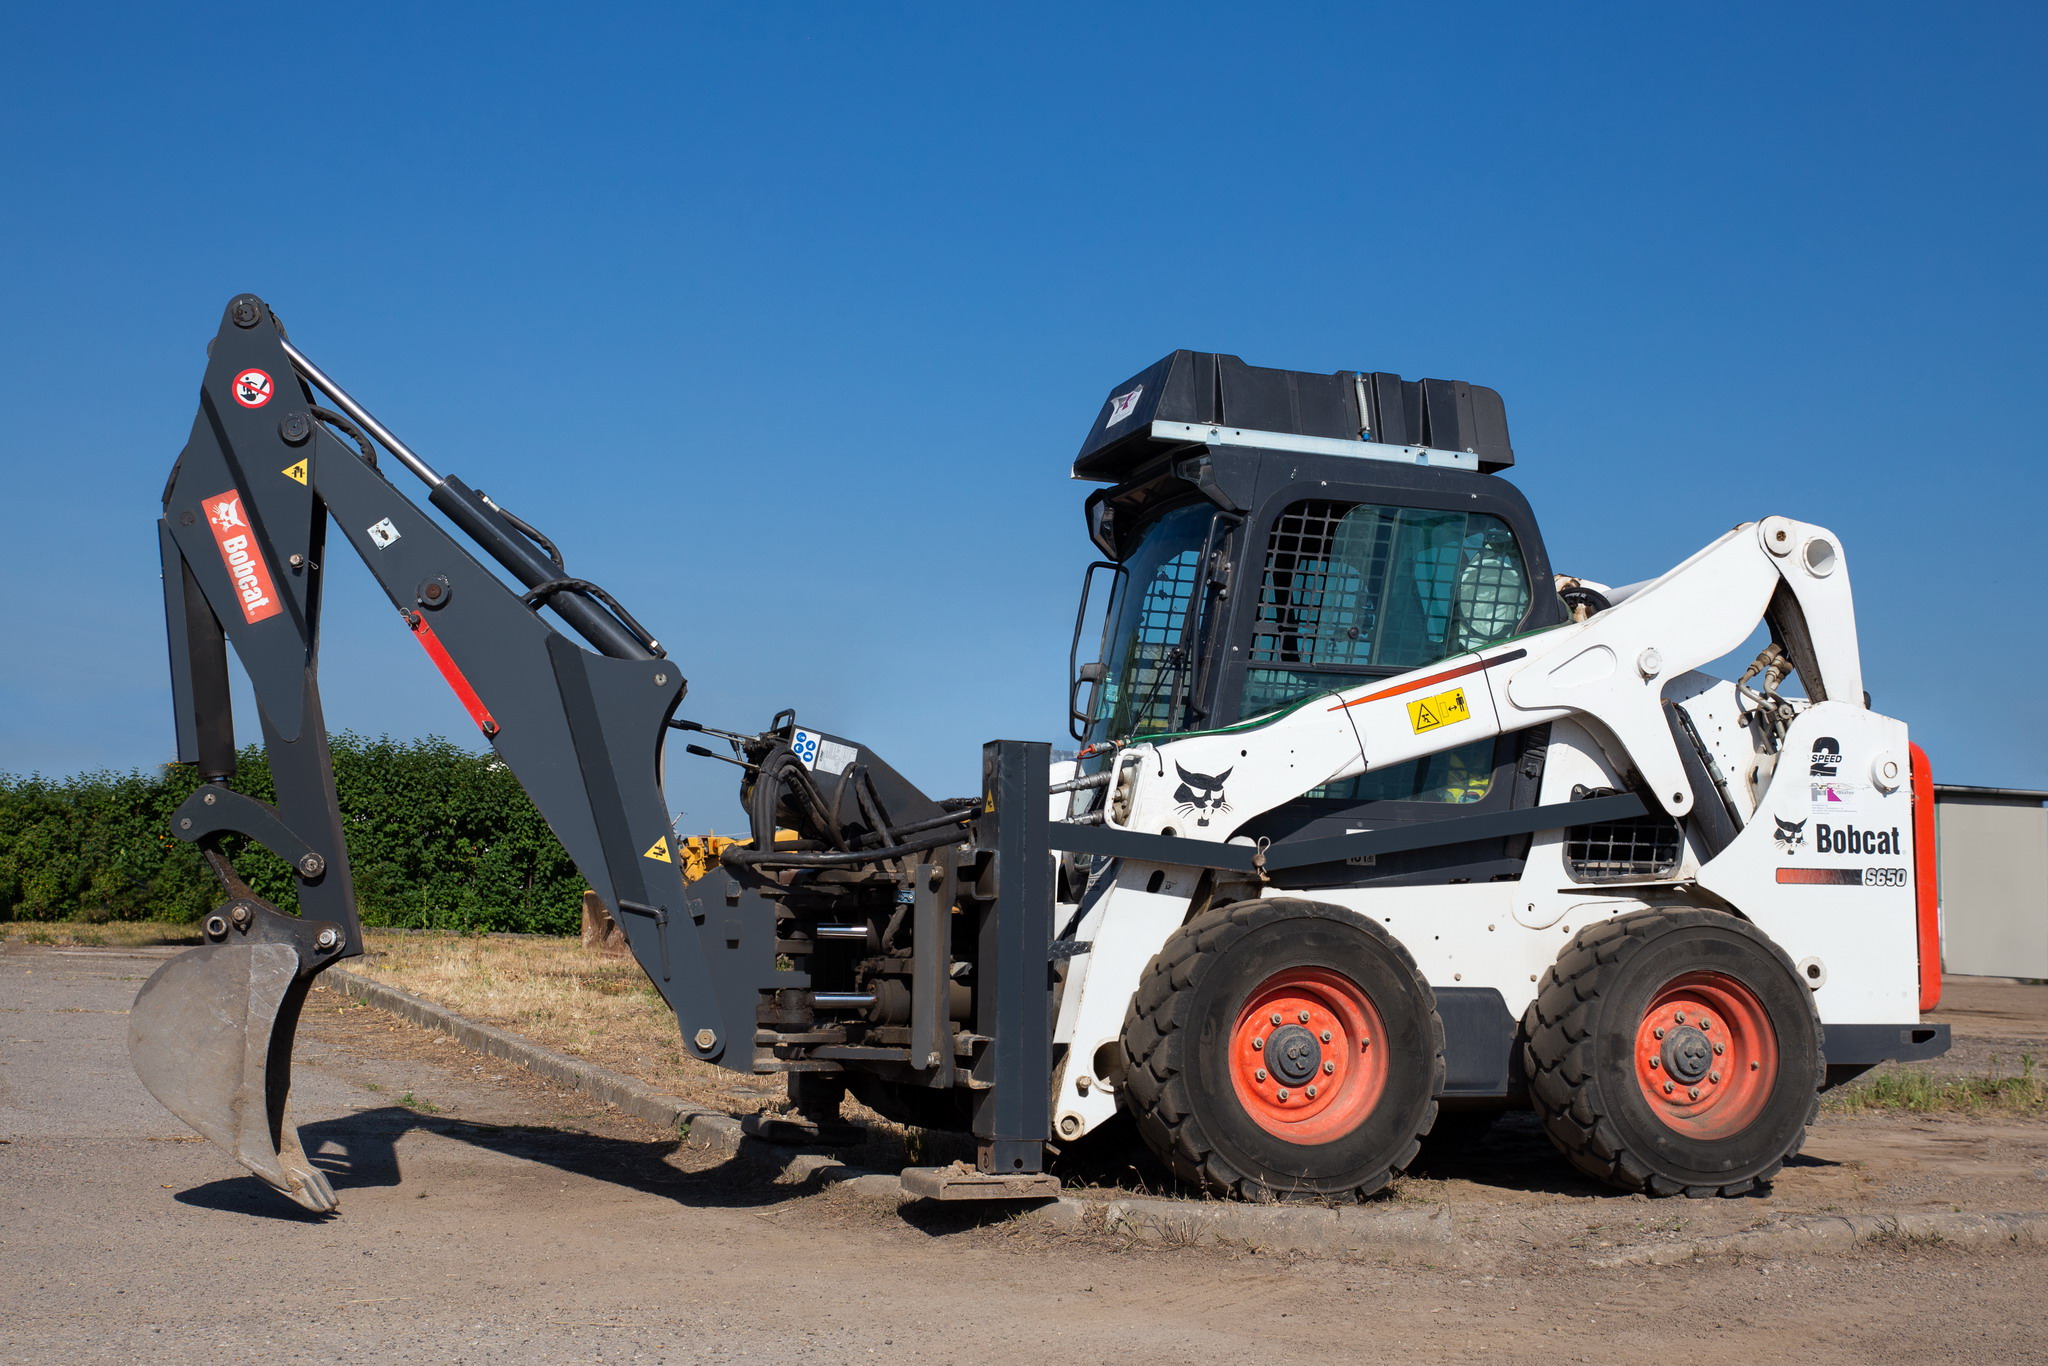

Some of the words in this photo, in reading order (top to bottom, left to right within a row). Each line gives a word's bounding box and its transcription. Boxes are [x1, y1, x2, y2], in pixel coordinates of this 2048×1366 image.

[222, 534, 270, 612] Bobcat
[1809, 736, 1840, 777] 2
[1811, 754, 1843, 764] SPEED
[1816, 823, 1901, 856] Bobcat
[1864, 867, 1908, 888] S650
